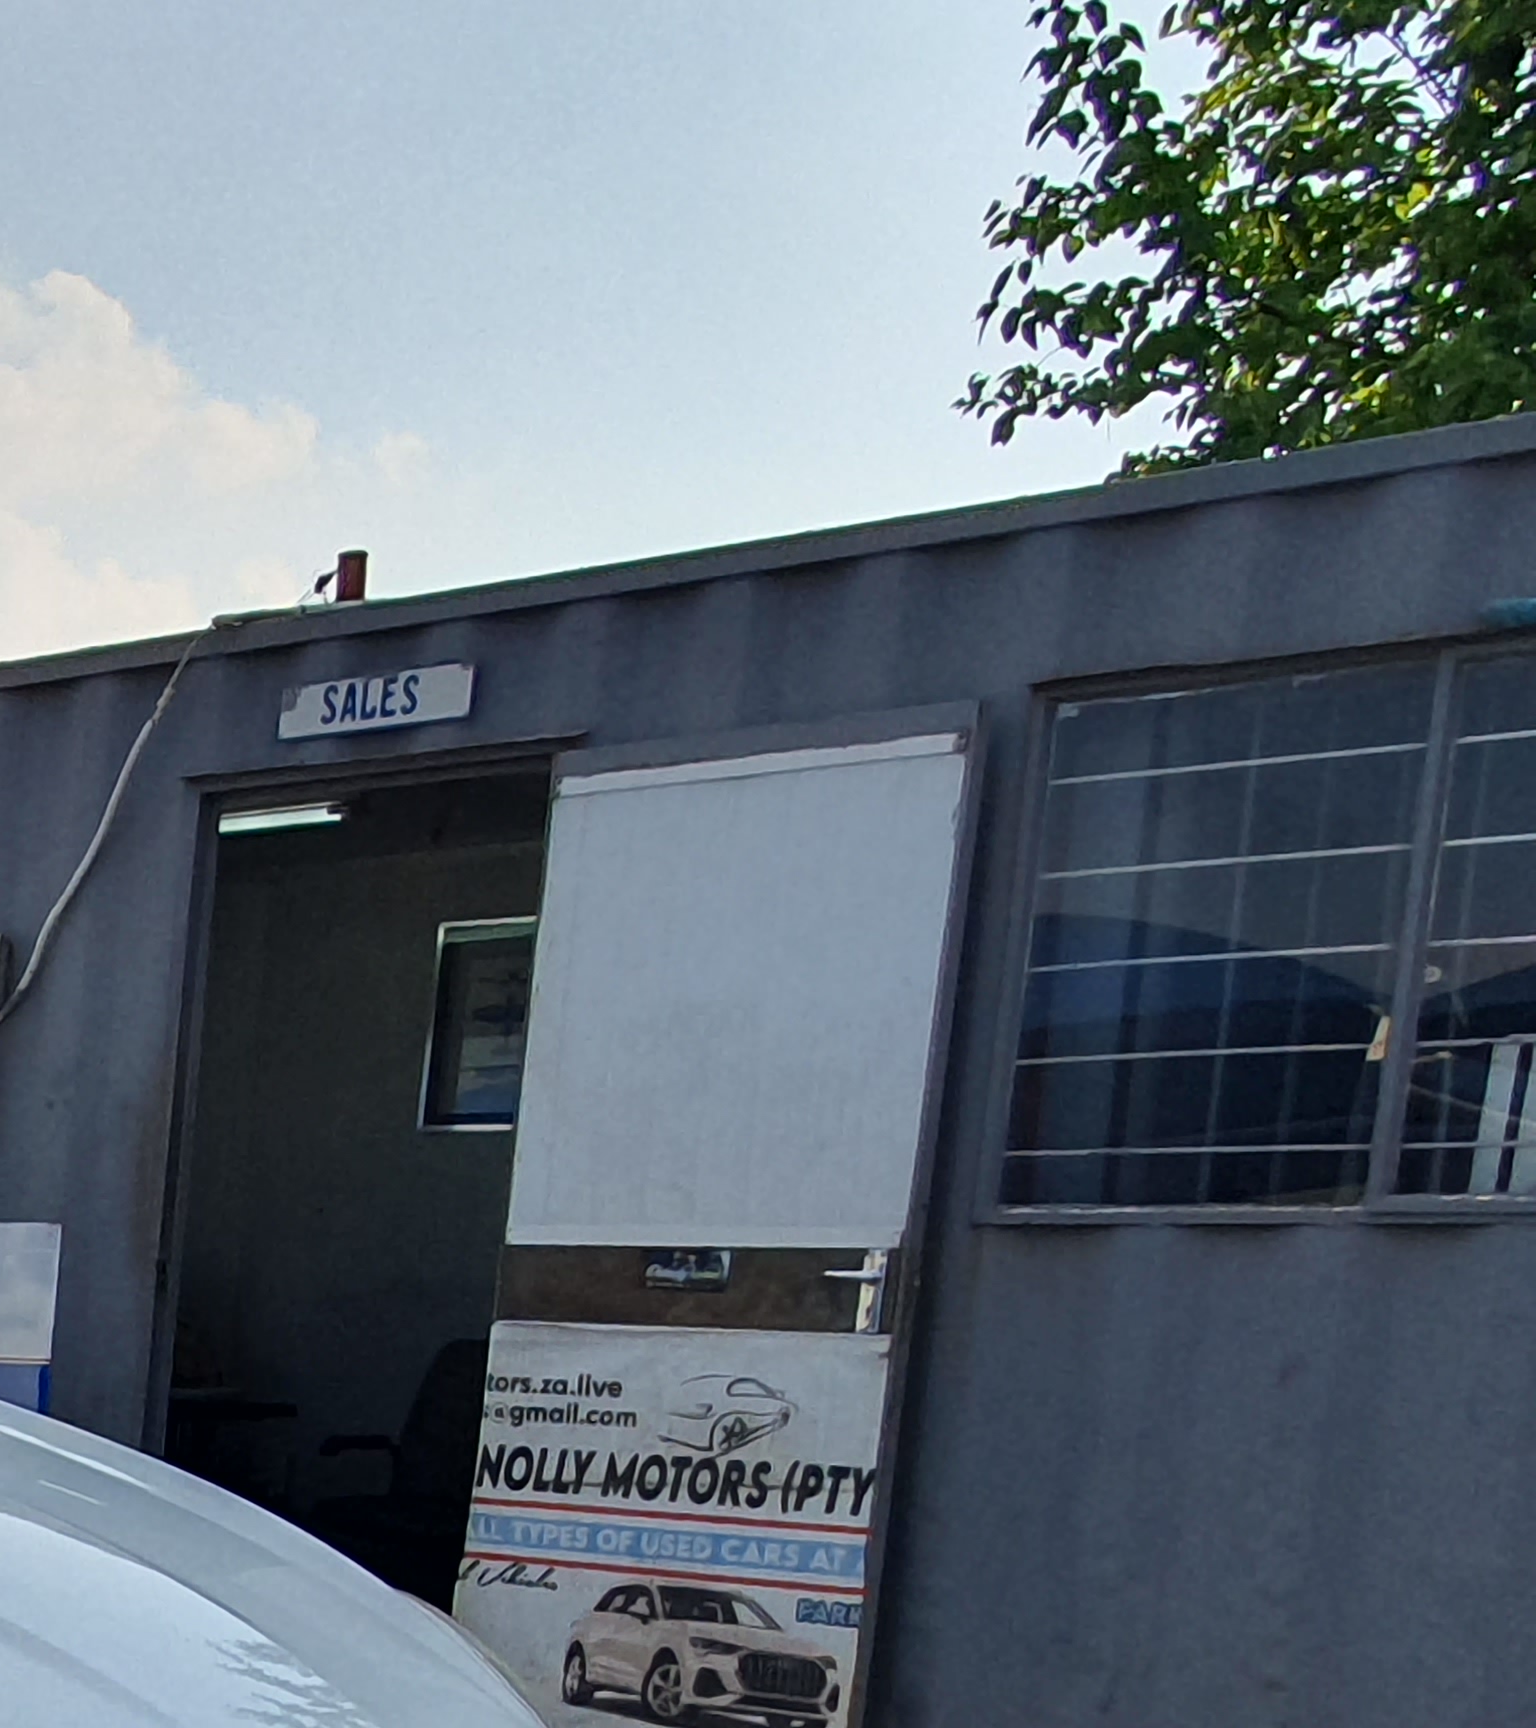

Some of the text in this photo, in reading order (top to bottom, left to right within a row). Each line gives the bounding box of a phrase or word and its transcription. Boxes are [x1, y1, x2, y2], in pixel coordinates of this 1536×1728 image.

[320, 674, 420, 726] SALES
[476, 1444, 876, 1517] NOLLY MOTORS (PTY
[469, 1514, 503, 1541] LL
[511, 1520, 589, 1549] TYPES
[596, 1528, 636, 1552] OF
[640, 1531, 713, 1560] USED
[720, 1538, 800, 1569] CARS
[809, 1548, 849, 1572] AT
